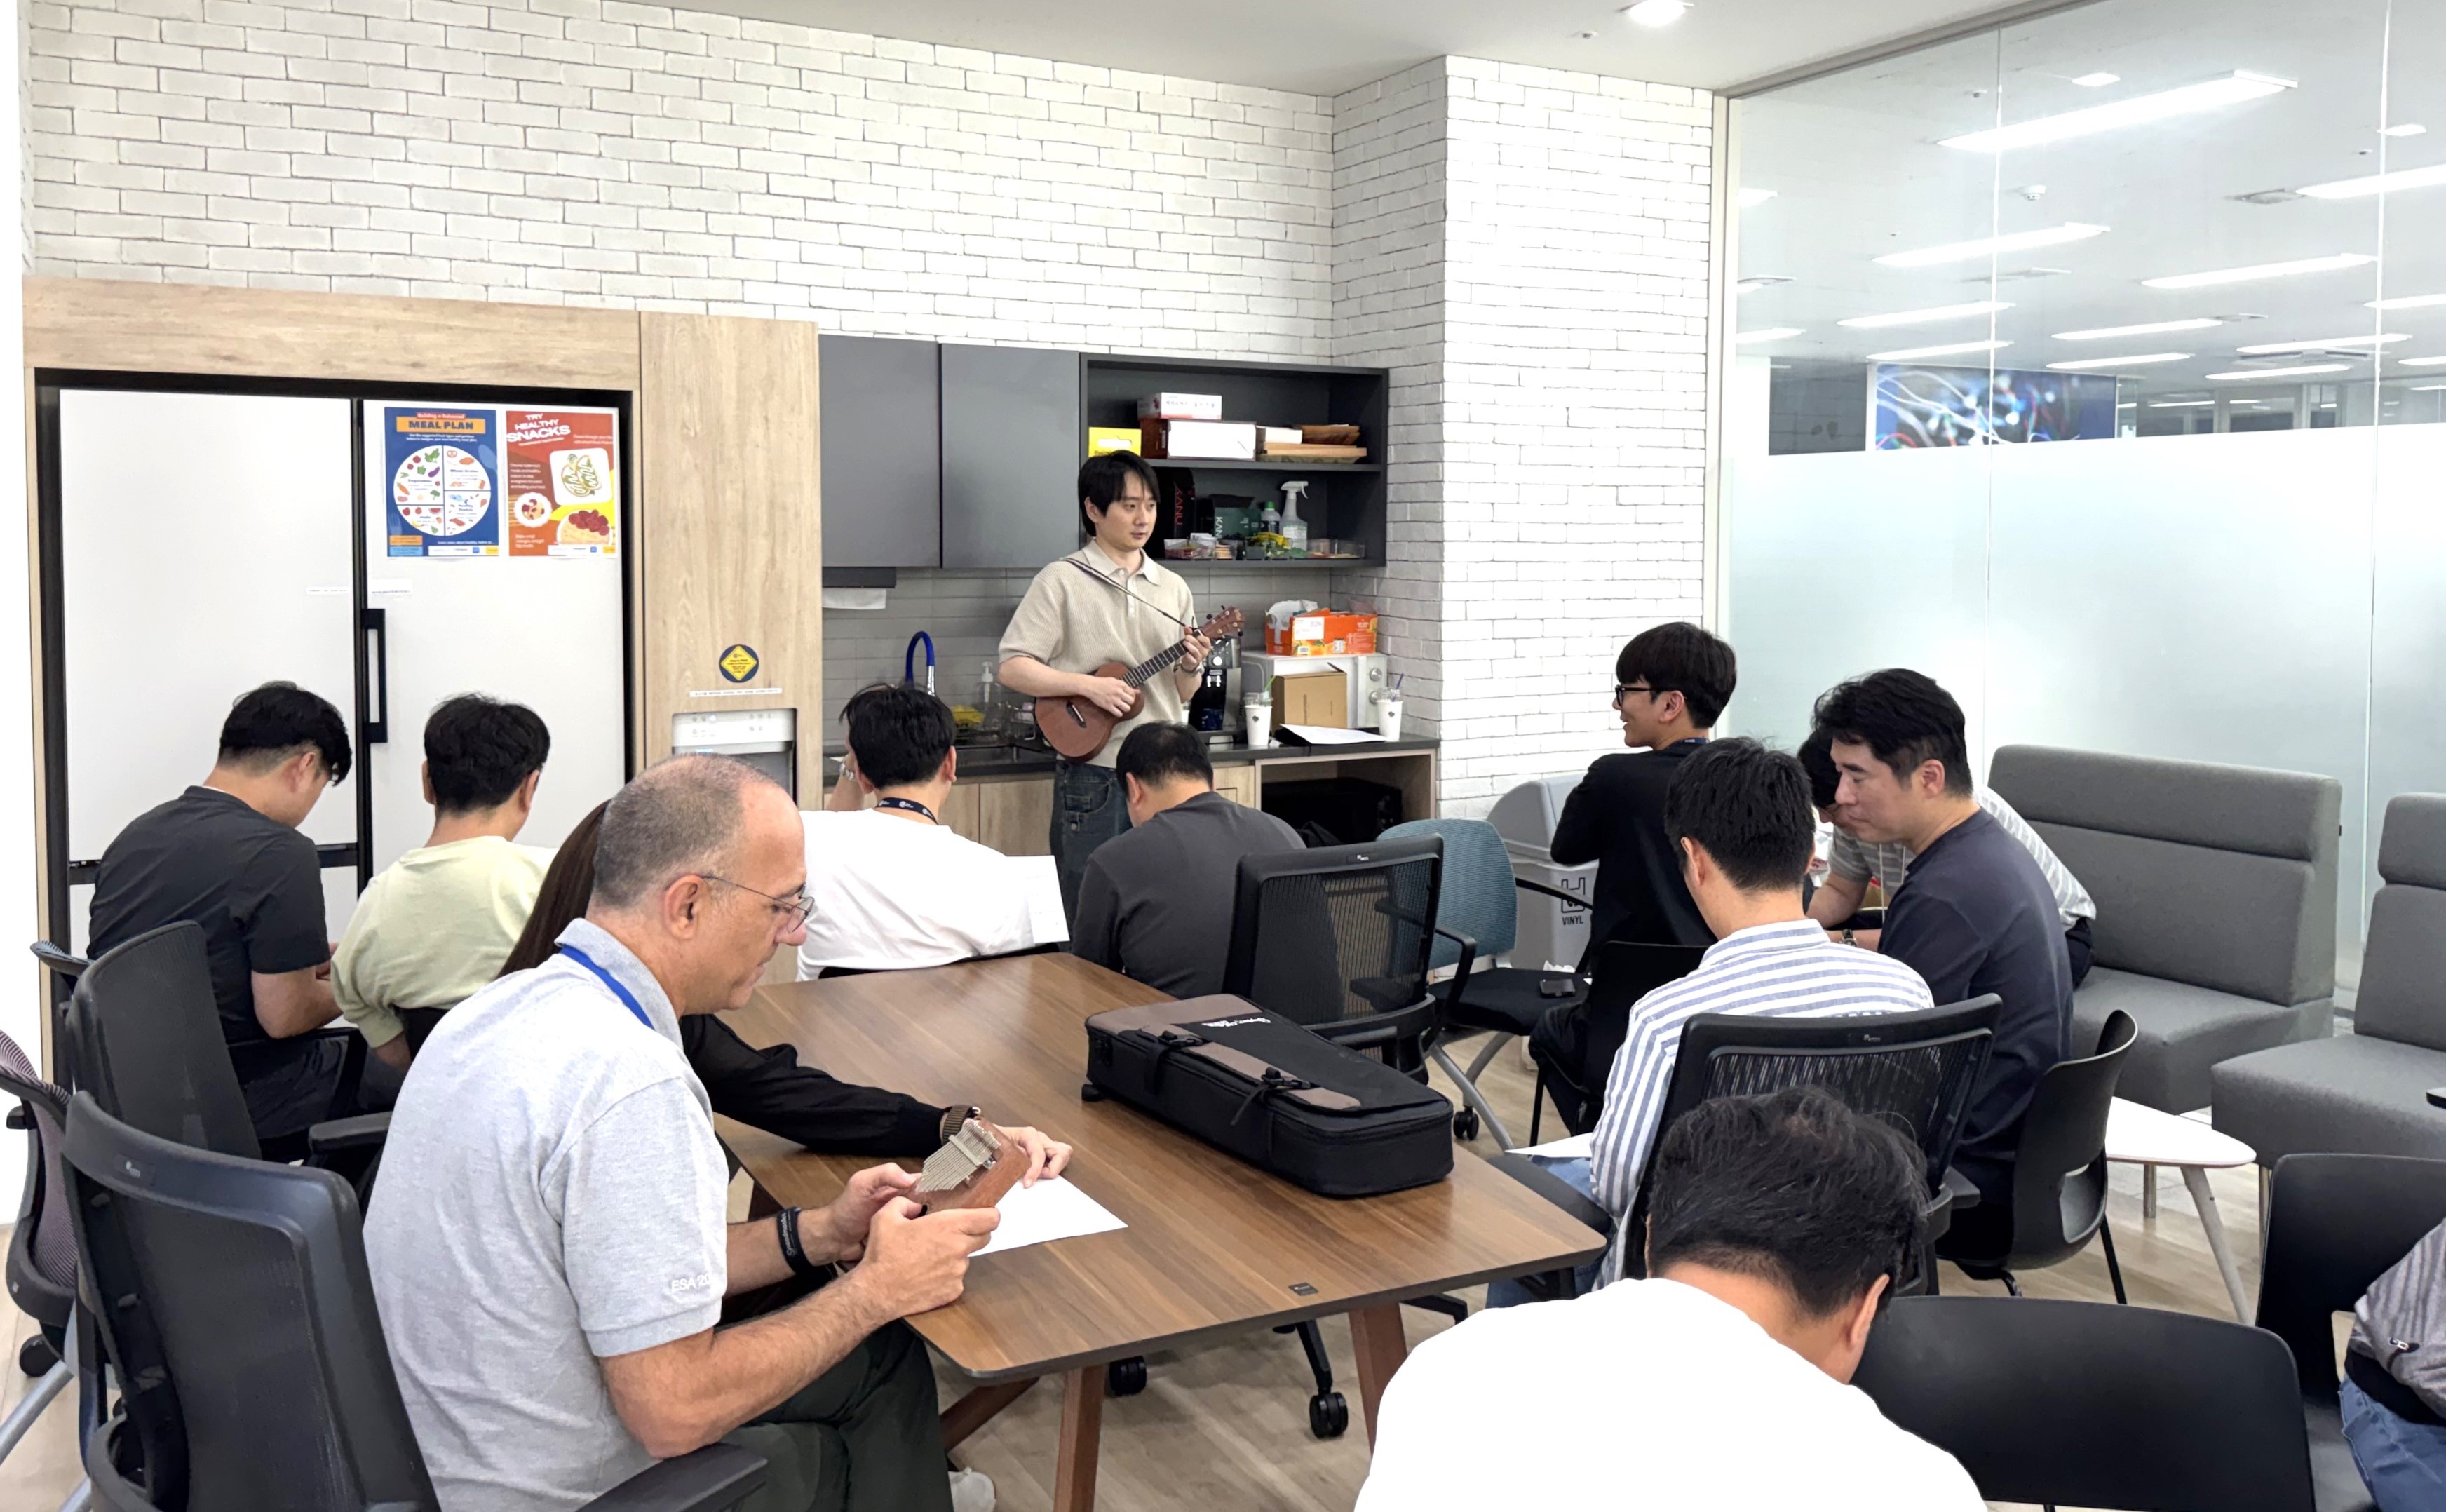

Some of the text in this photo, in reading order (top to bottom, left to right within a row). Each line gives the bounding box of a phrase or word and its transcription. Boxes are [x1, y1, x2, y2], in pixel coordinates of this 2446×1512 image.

[408, 421, 474, 430] MEAL PLAN
[514, 419, 559, 431] HEALTHY
[506, 425, 572, 443] SNACKS
[1562, 915, 1583, 926] VINYL
[671, 1277, 696, 1292] ESA
